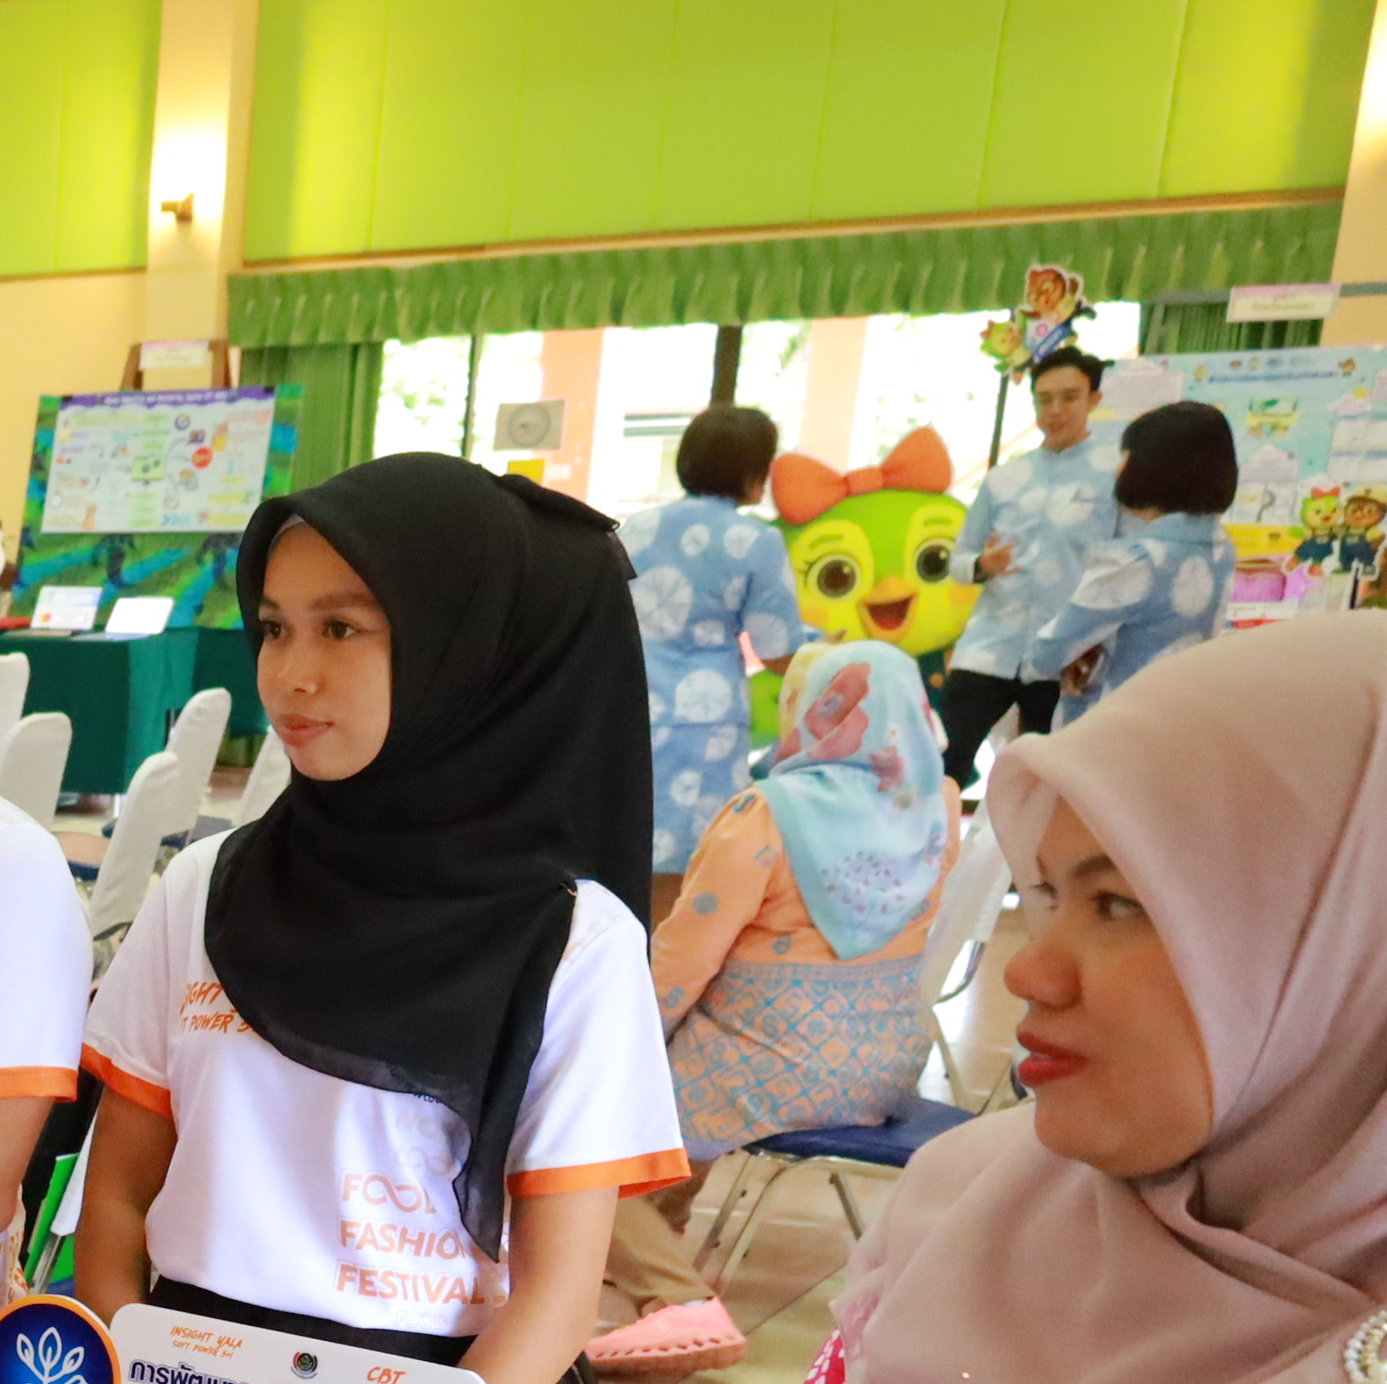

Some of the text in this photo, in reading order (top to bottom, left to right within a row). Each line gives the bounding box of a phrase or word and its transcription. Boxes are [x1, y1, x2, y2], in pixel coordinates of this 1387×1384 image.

[336, 1263, 485, 1305] FESTIVAL
[170, 1325, 244, 1350] INSIGHT YALA
